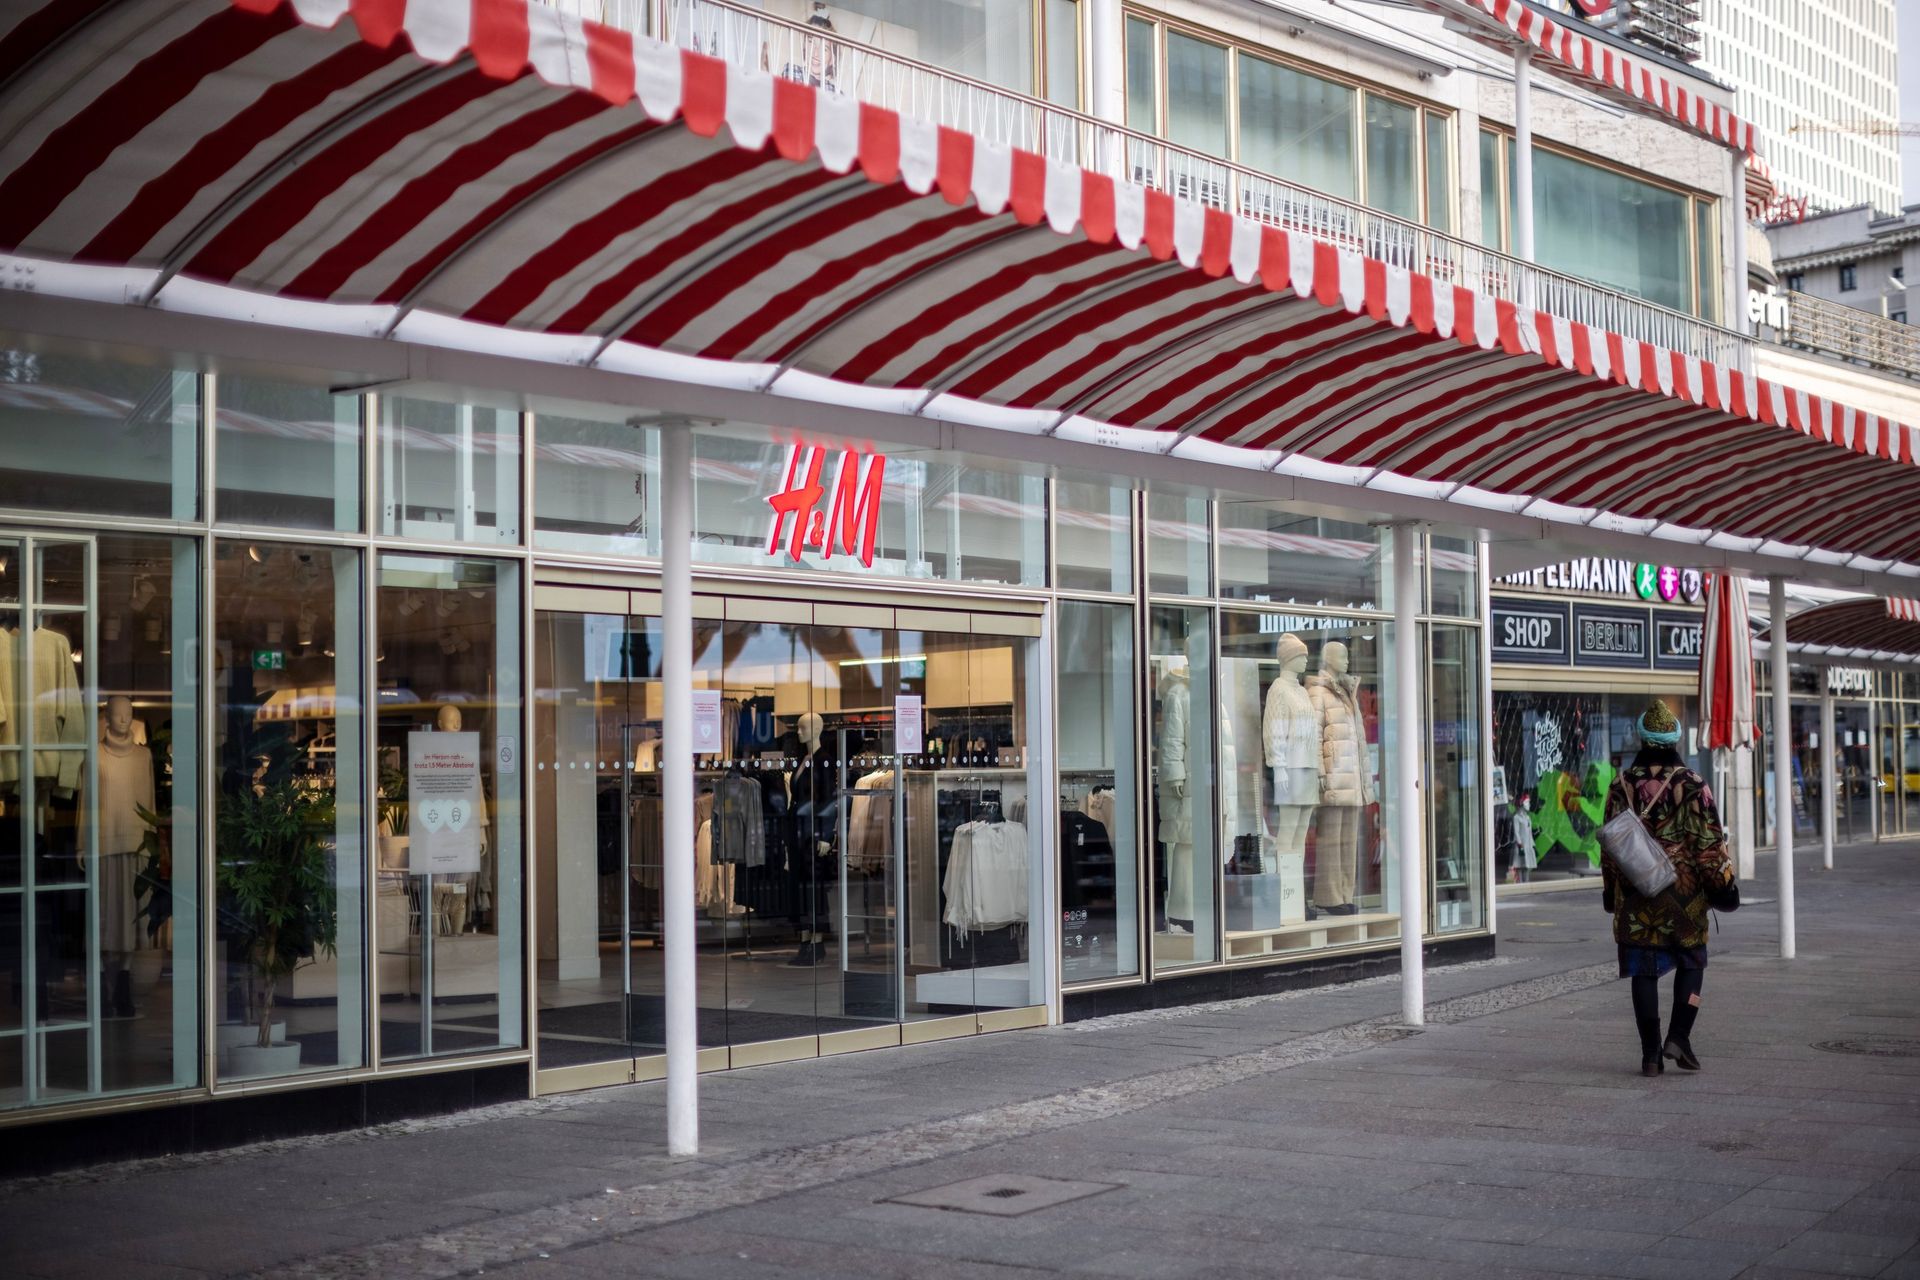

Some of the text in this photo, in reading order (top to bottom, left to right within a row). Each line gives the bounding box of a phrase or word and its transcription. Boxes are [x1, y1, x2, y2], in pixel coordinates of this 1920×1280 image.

[764, 442, 886, 568] H&M
[1504, 616, 1551, 647] SHOP
[1585, 621, 1639, 652] BERLIN
